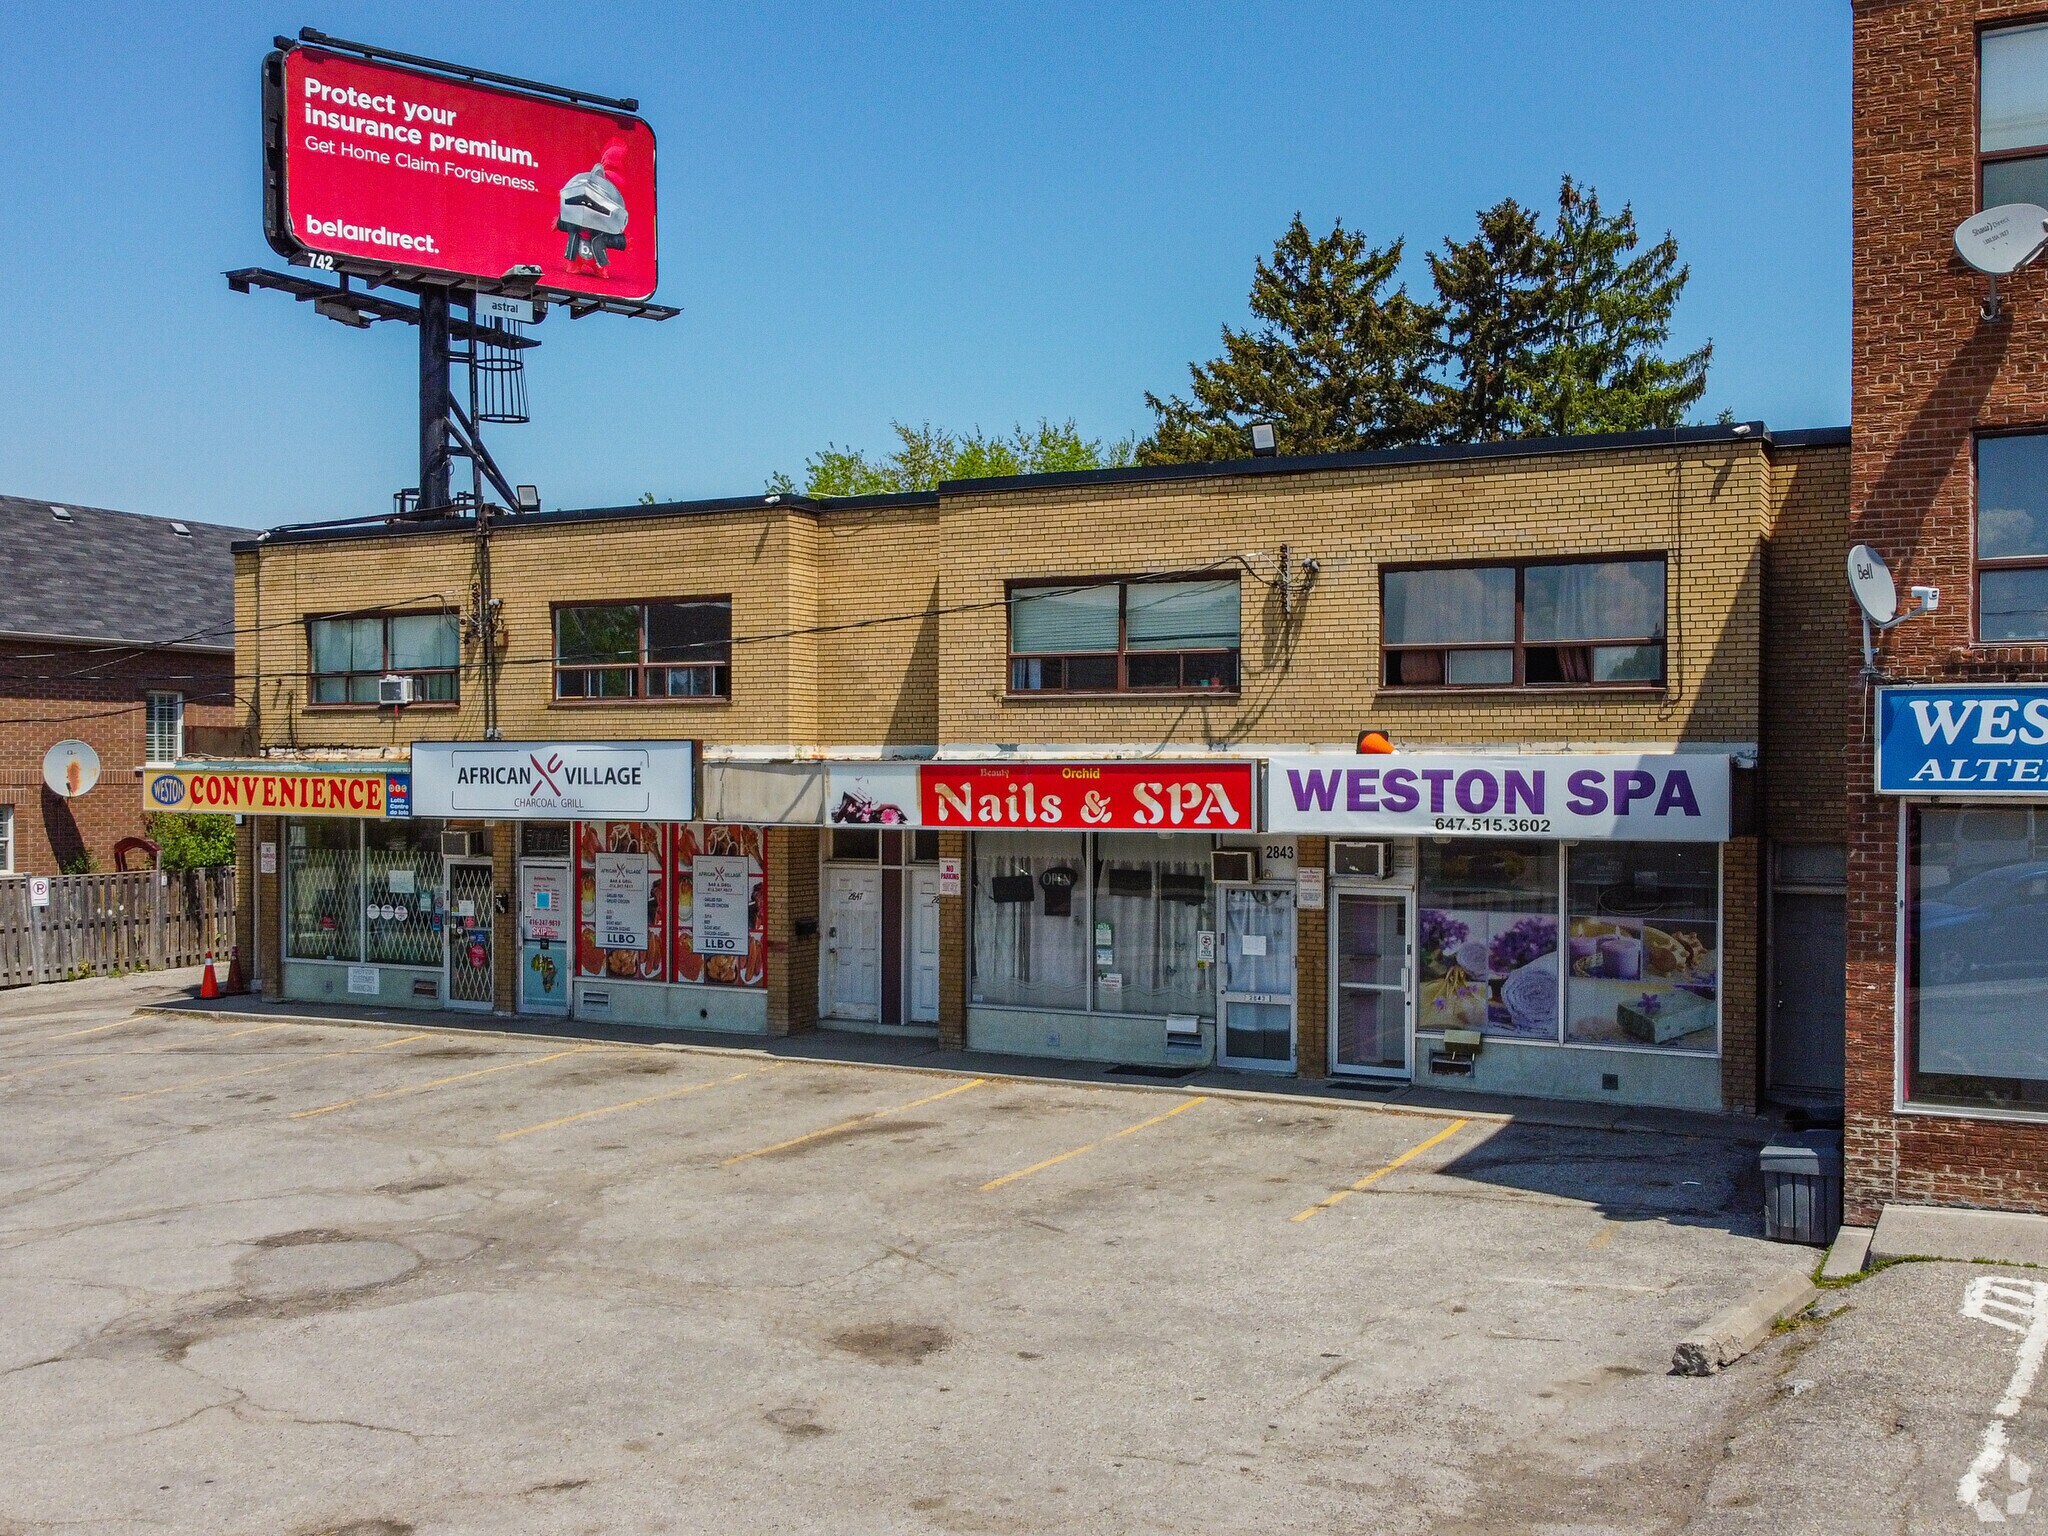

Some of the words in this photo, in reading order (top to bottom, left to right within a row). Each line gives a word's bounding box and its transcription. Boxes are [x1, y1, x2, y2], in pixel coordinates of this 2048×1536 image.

[304, 77, 396, 115] Protect
[402, 101, 457, 127] your
[304, 102, 422, 145] insurance
[429, 132, 539, 168] premium.
[305, 135, 336, 155] Get
[341, 141, 391, 165] Home
[395, 152, 440, 174] Claim
[444, 161, 539, 192] Forgiveness.
[308, 252, 335, 271] 742
[491, 302, 519, 314] astral
[1857, 563, 1874, 580] Bell
[1908, 698, 2048, 746] WES
[457, 767, 531, 785] AFRICAN
[564, 767, 642, 785] VILLAGE
[980, 768, 1010, 780] Beauty
[1061, 767, 1101, 780] Orchid
[1908, 758, 2048, 782] ALTE
[153, 778, 185, 803] WESTON
[189, 775, 382, 811] CONVENIENCE
[1286, 768, 1546, 815] WESTON
[1565, 769, 1702, 817] SPA
[514, 797, 558, 808] CHARCOAL
[560, 798, 585, 808] GRILL
[933, 782, 1062, 823] Nails
[1080, 789, 1113, 824] &
[1132, 782, 1240, 825] SPA
[1434, 817, 1552, 833] 647.515.3602
[1266, 845, 1294, 859] 2843
[946, 865, 954, 873] NO
[1042, 872, 1072, 886] OPEN
[532, 926, 547, 936] SKIP
[607, 933, 636, 944] LLBO
[705, 938, 735, 949] LLBO
